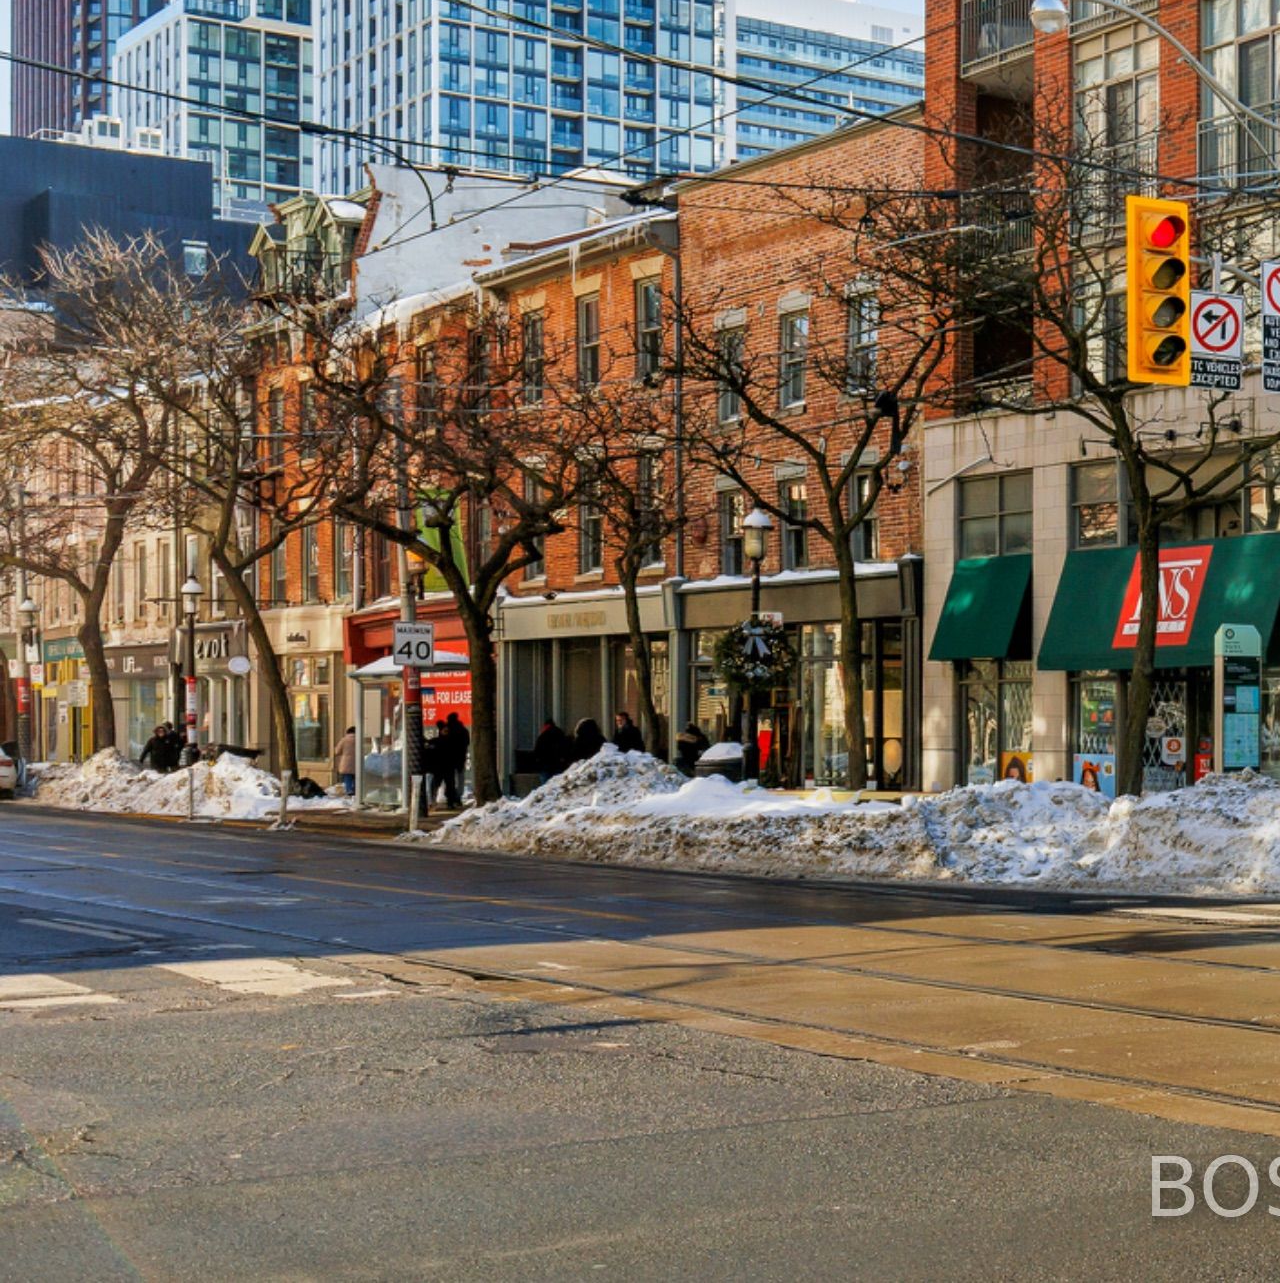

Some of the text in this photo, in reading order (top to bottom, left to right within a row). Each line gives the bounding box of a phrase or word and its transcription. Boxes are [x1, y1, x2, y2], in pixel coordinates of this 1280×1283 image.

[1265, 337, 1279, 348] AND
[1206, 361, 1240, 375] VEHICLES
[1191, 373, 1238, 387] EXCEPTED
[397, 641, 431, 660] 40
[436, 691, 450, 704] FOR
